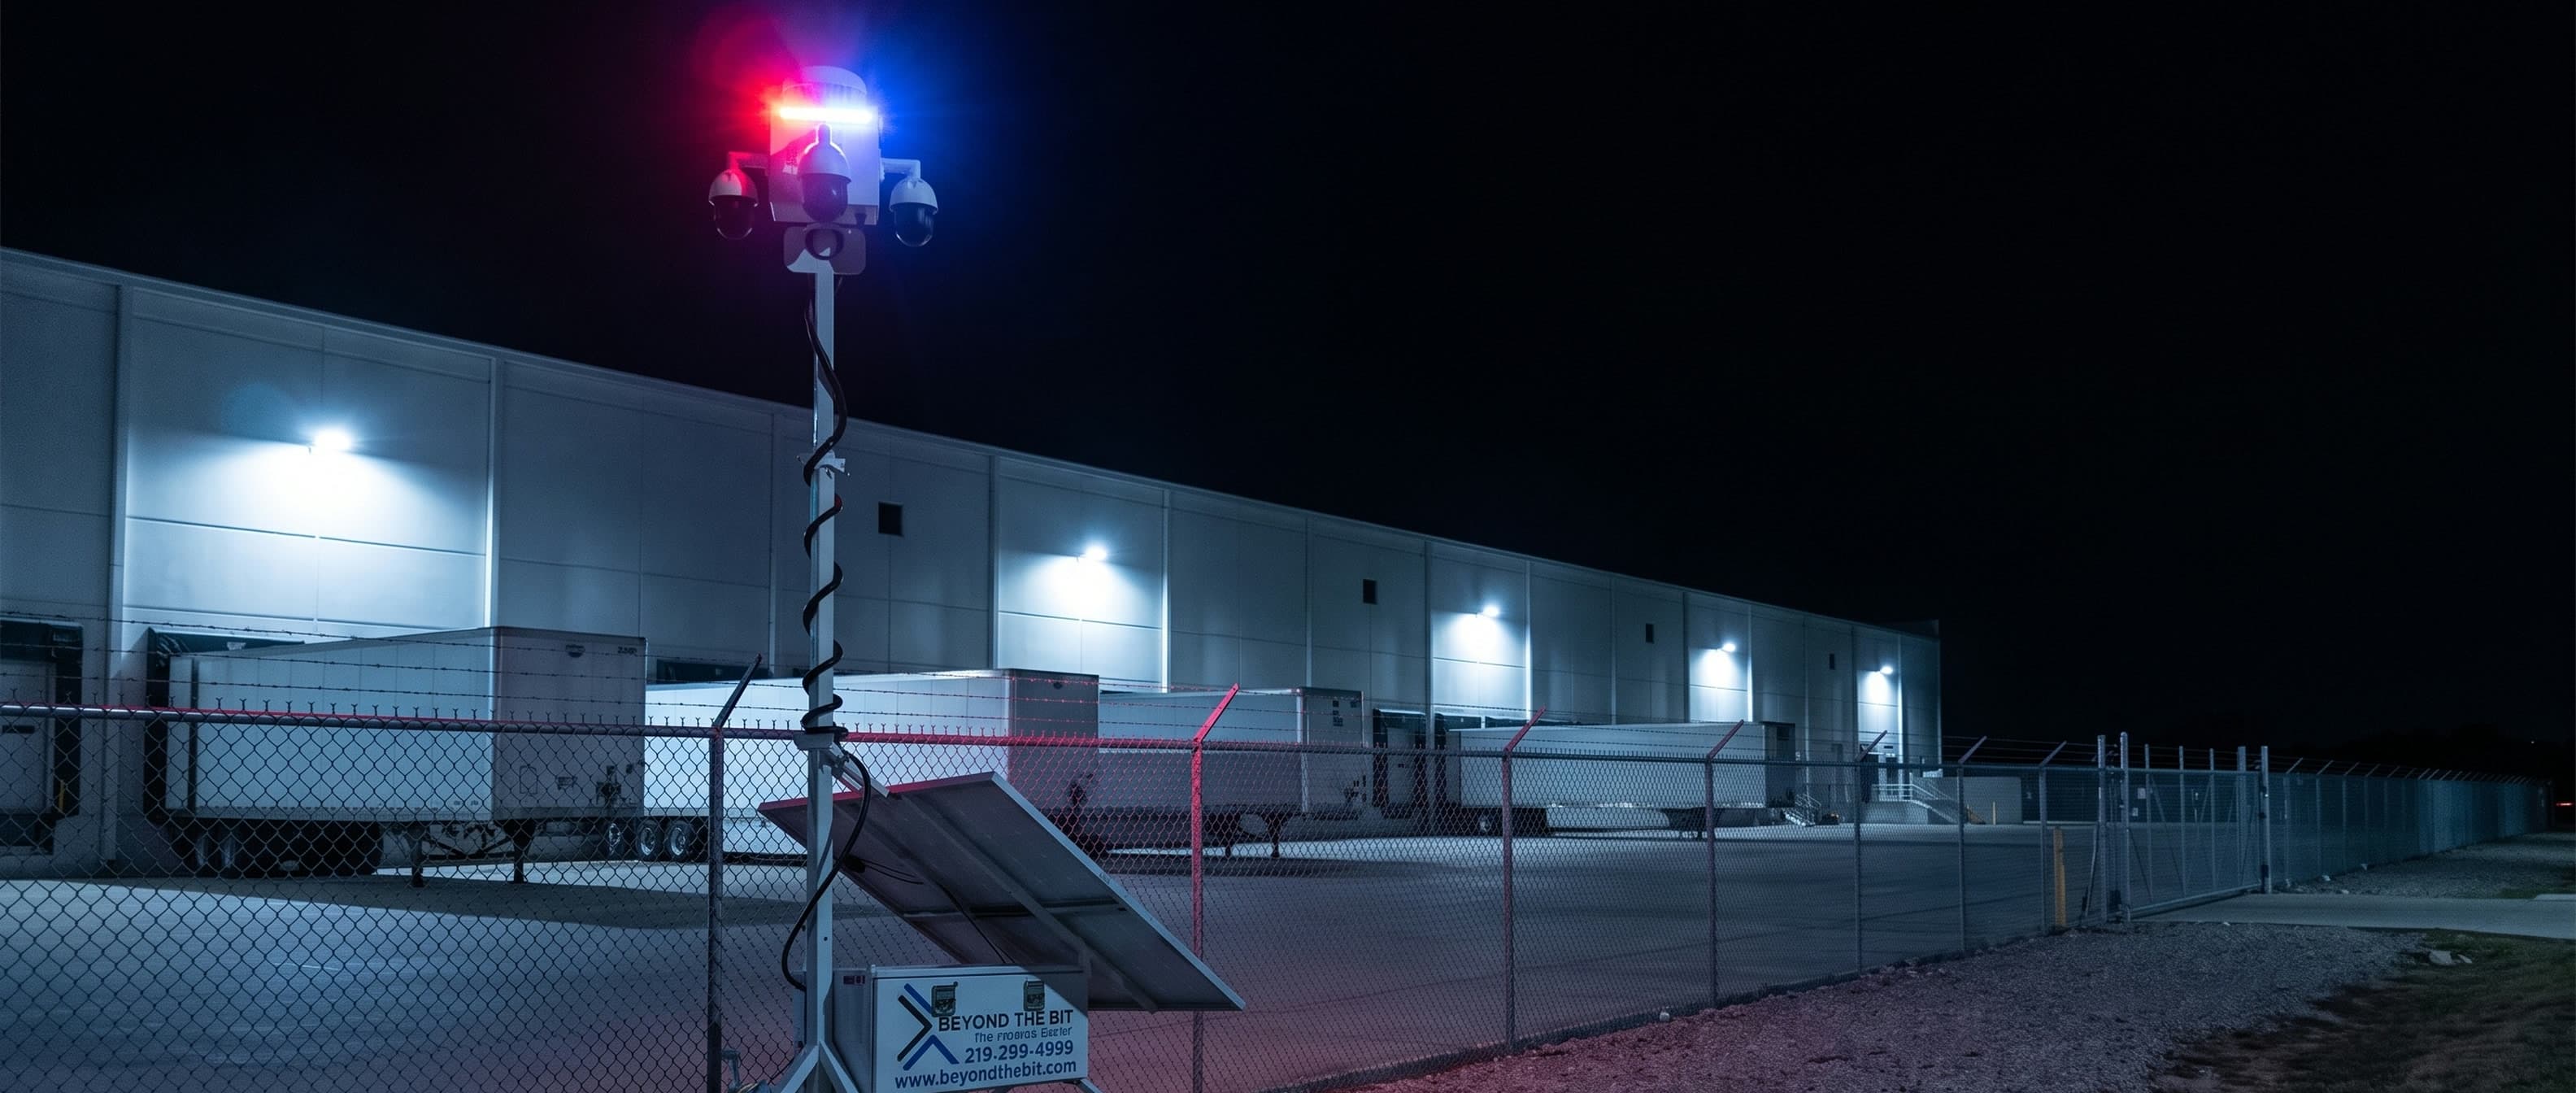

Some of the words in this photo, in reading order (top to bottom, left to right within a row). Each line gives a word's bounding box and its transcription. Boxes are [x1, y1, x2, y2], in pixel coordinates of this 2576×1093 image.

[938, 1013, 1009, 1032] BEYOND
[1014, 1011, 1045, 1027] THE
[1049, 1009, 1074, 1026] BIT
[895, 1060, 1077, 1088] www.beyondthebit.com
